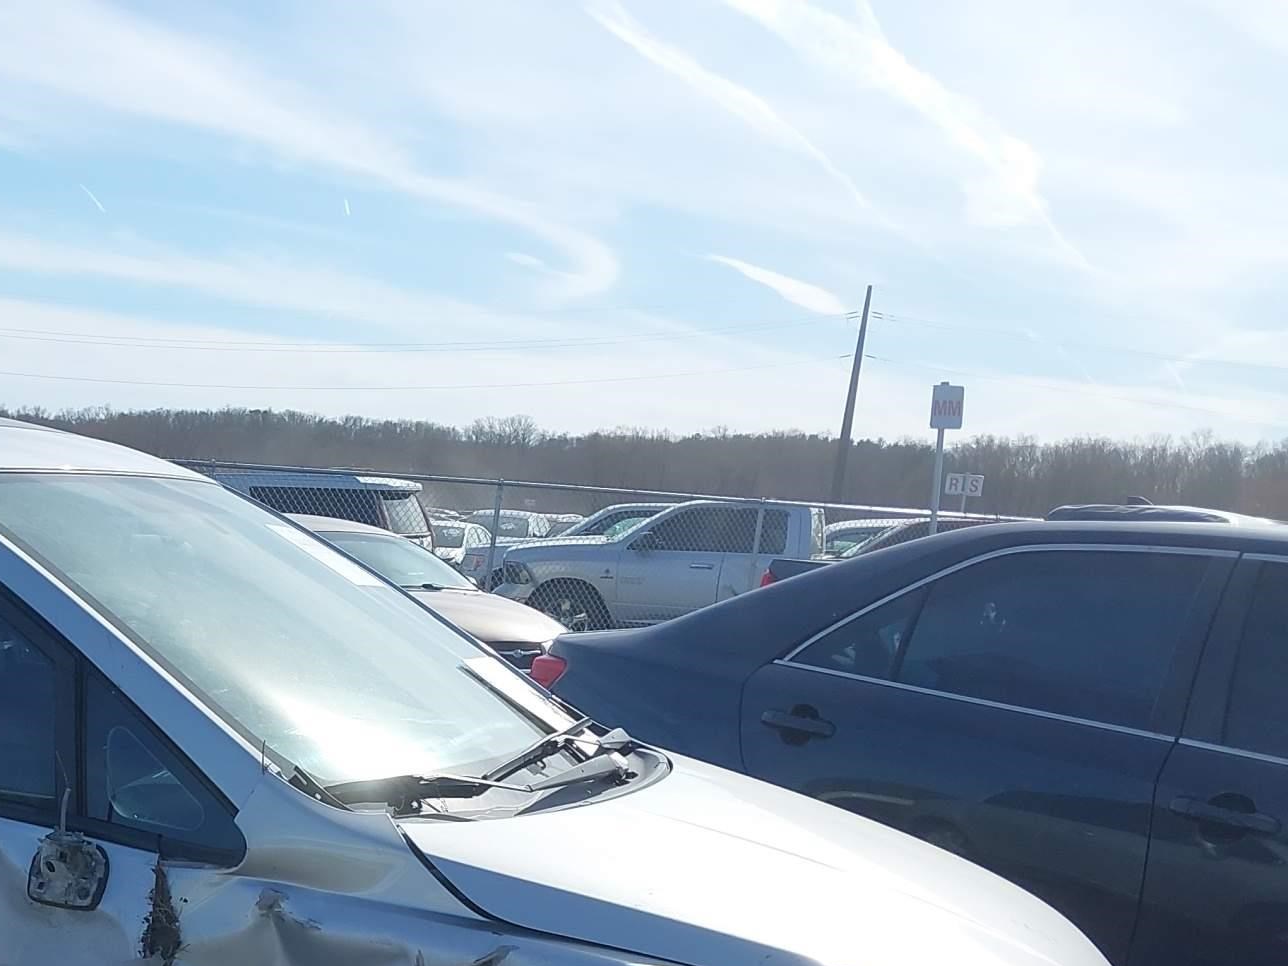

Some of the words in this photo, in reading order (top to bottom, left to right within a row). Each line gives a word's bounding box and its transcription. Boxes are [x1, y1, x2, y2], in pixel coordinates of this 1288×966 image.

[933, 400, 962, 417] MM
[949, 478, 959, 491] R
[969, 479, 979, 492] S
